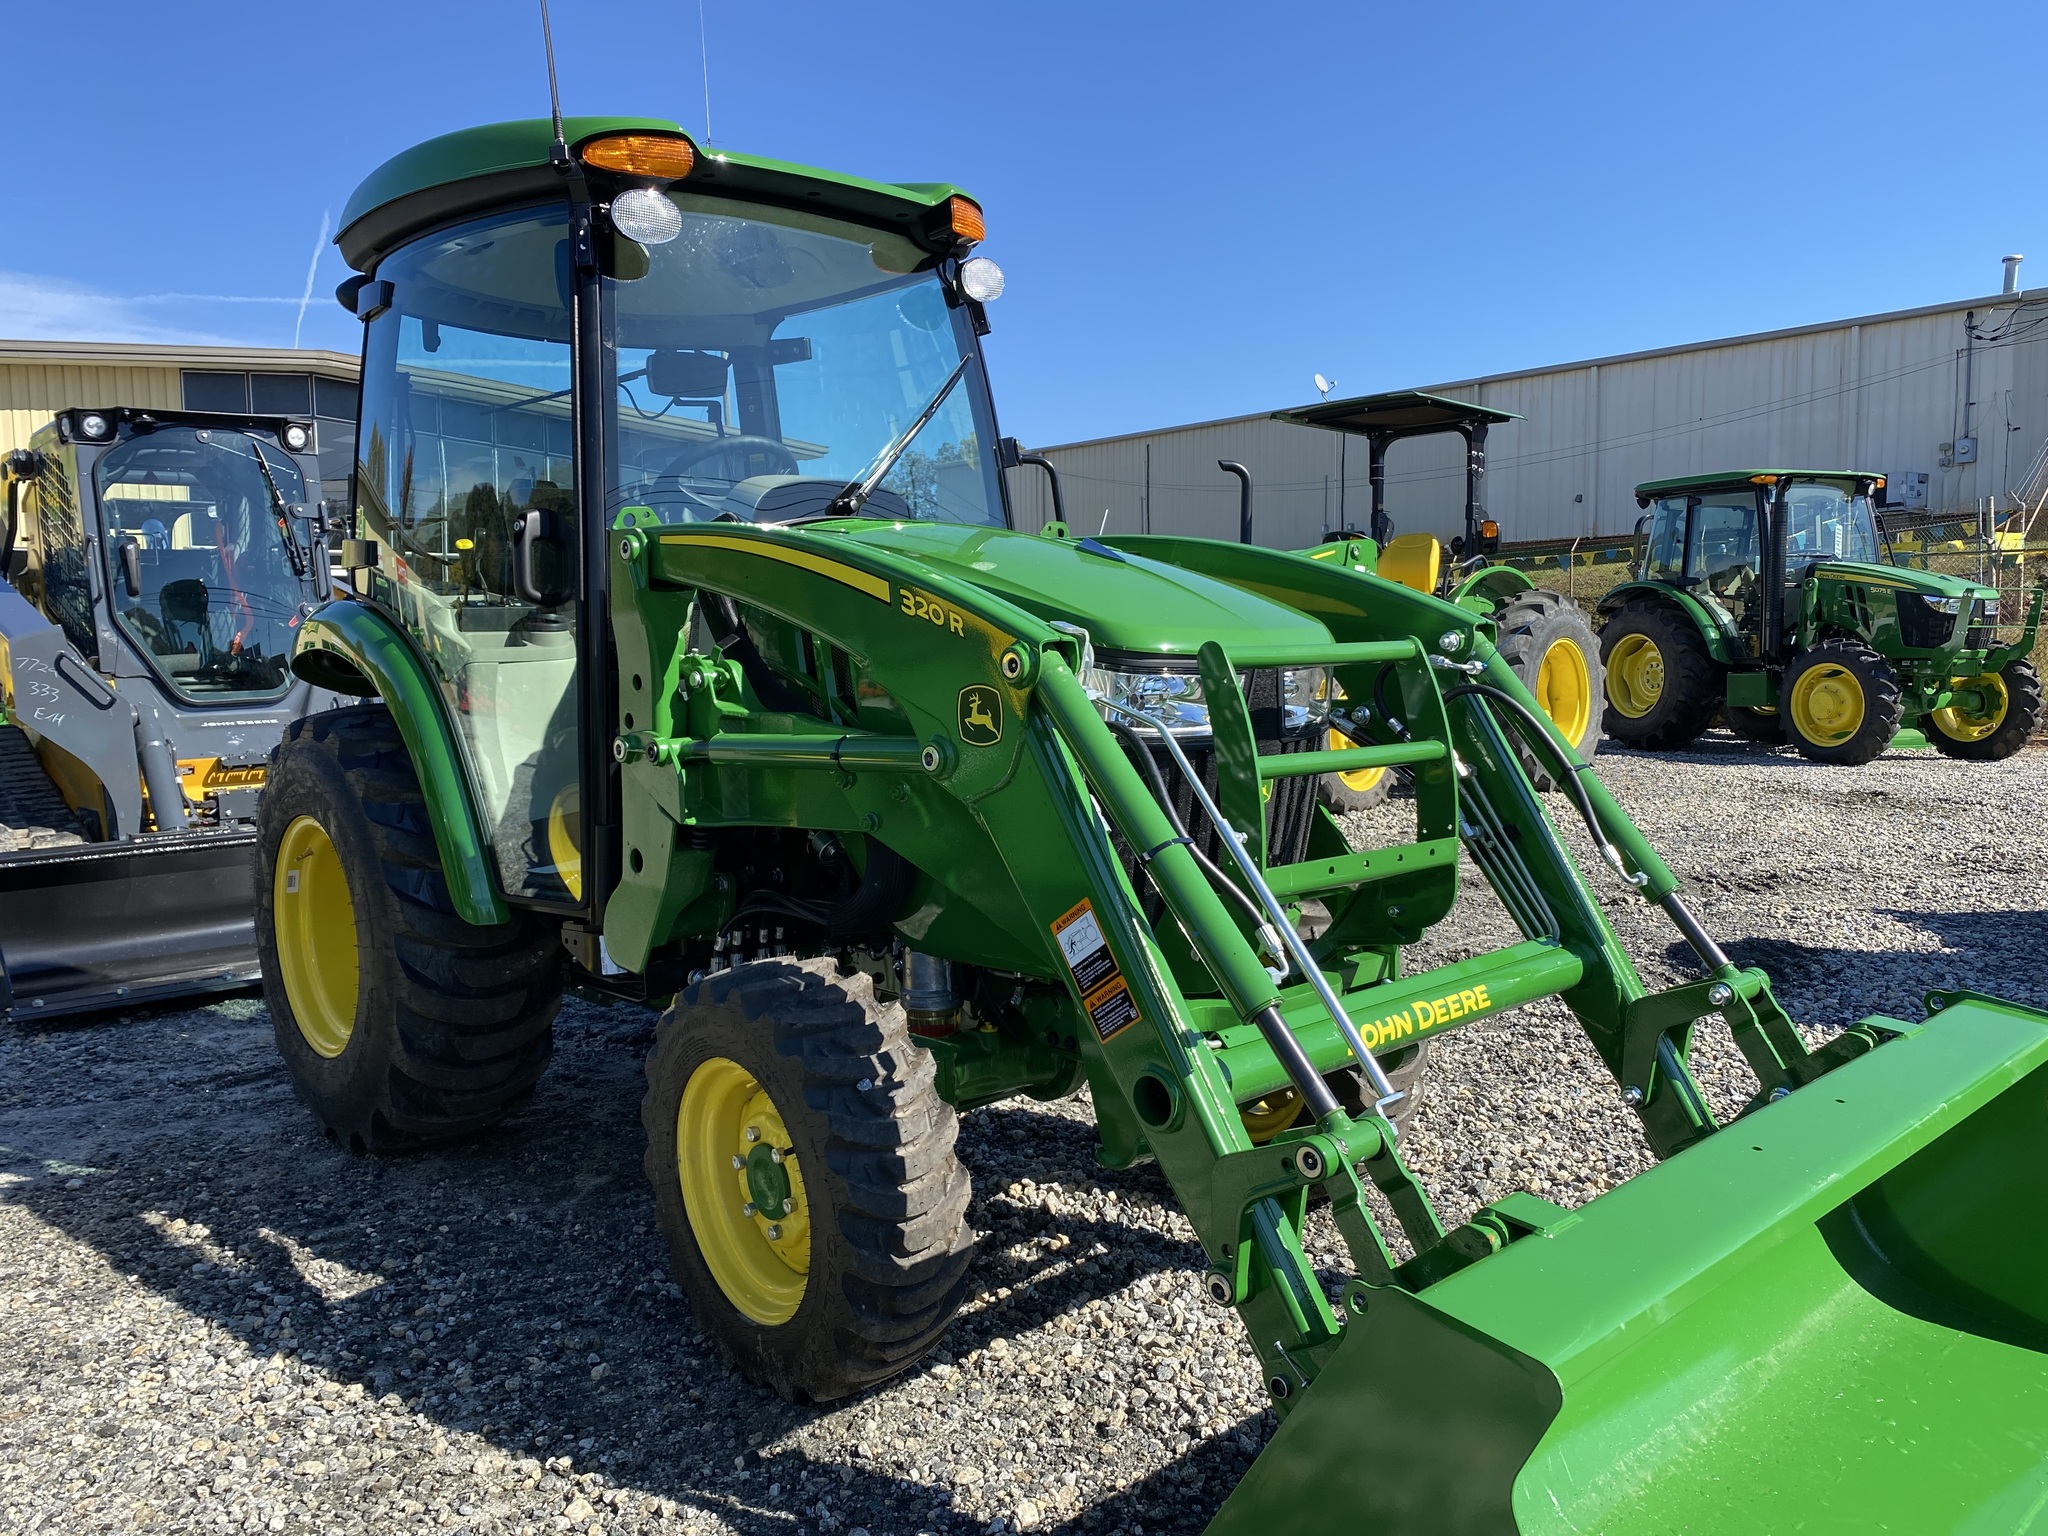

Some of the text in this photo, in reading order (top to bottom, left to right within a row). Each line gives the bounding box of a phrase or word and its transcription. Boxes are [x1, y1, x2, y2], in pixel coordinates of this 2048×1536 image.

[899, 588, 966, 638] 320 R
[28, 681, 60, 703] 333
[1060, 903, 1086, 925] WARNING
[1095, 981, 1122, 1003] WARNING
[1347, 984, 1492, 1056] OHN DEERE
